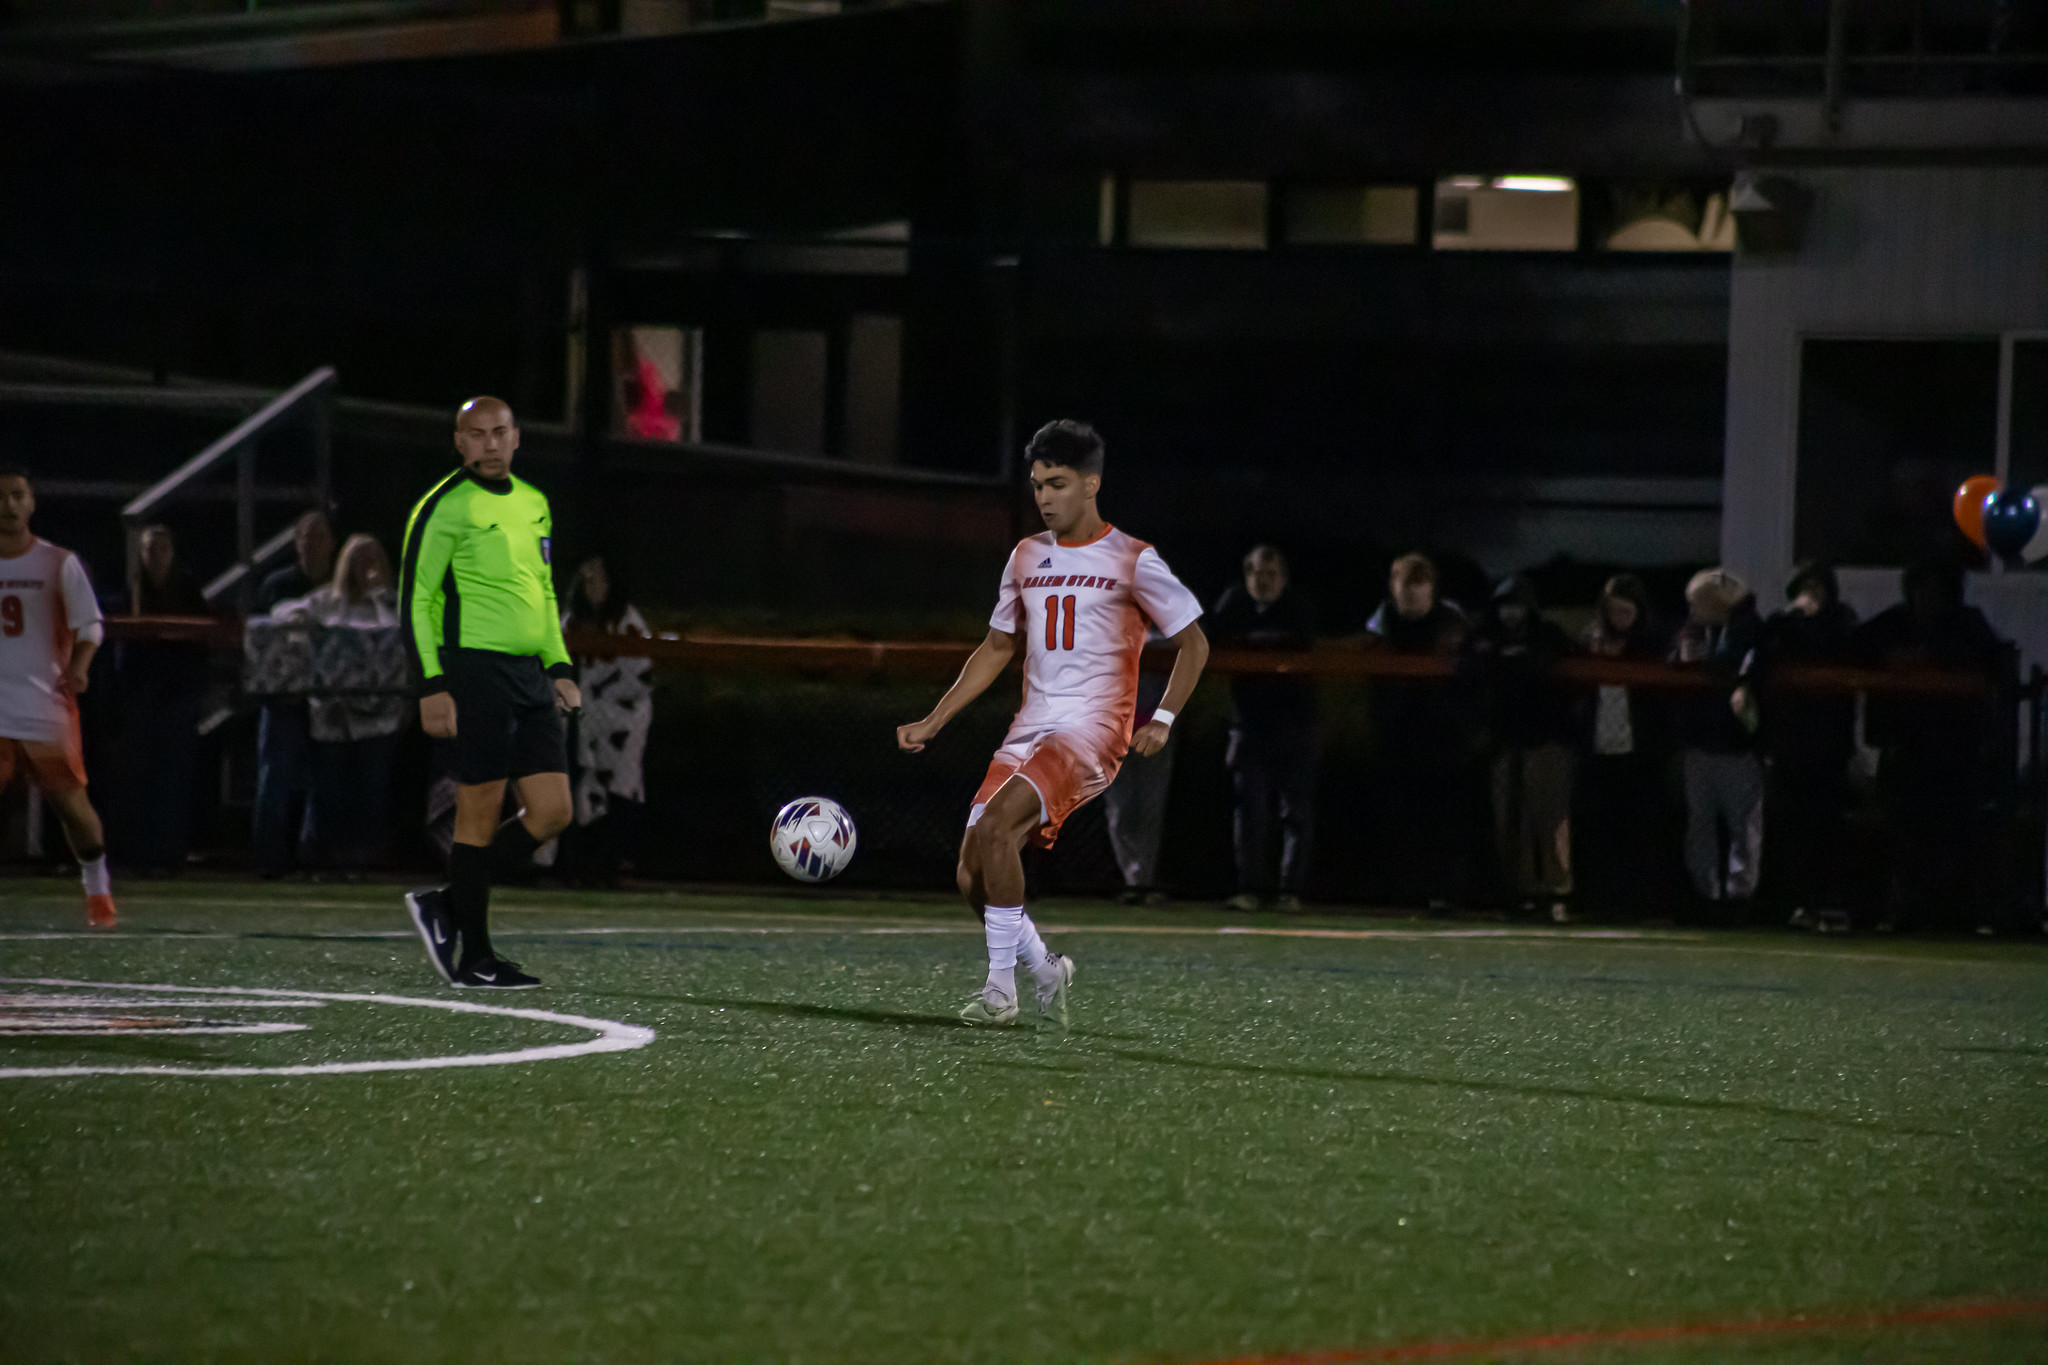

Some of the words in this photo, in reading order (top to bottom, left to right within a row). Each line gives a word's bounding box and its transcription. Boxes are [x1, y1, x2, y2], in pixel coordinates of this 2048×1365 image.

[1022, 575, 1066, 589] SALEM
[1066, 575, 1117, 590] STATE
[1, 595, 23, 637] 9
[1045, 594, 1076, 651] 11
